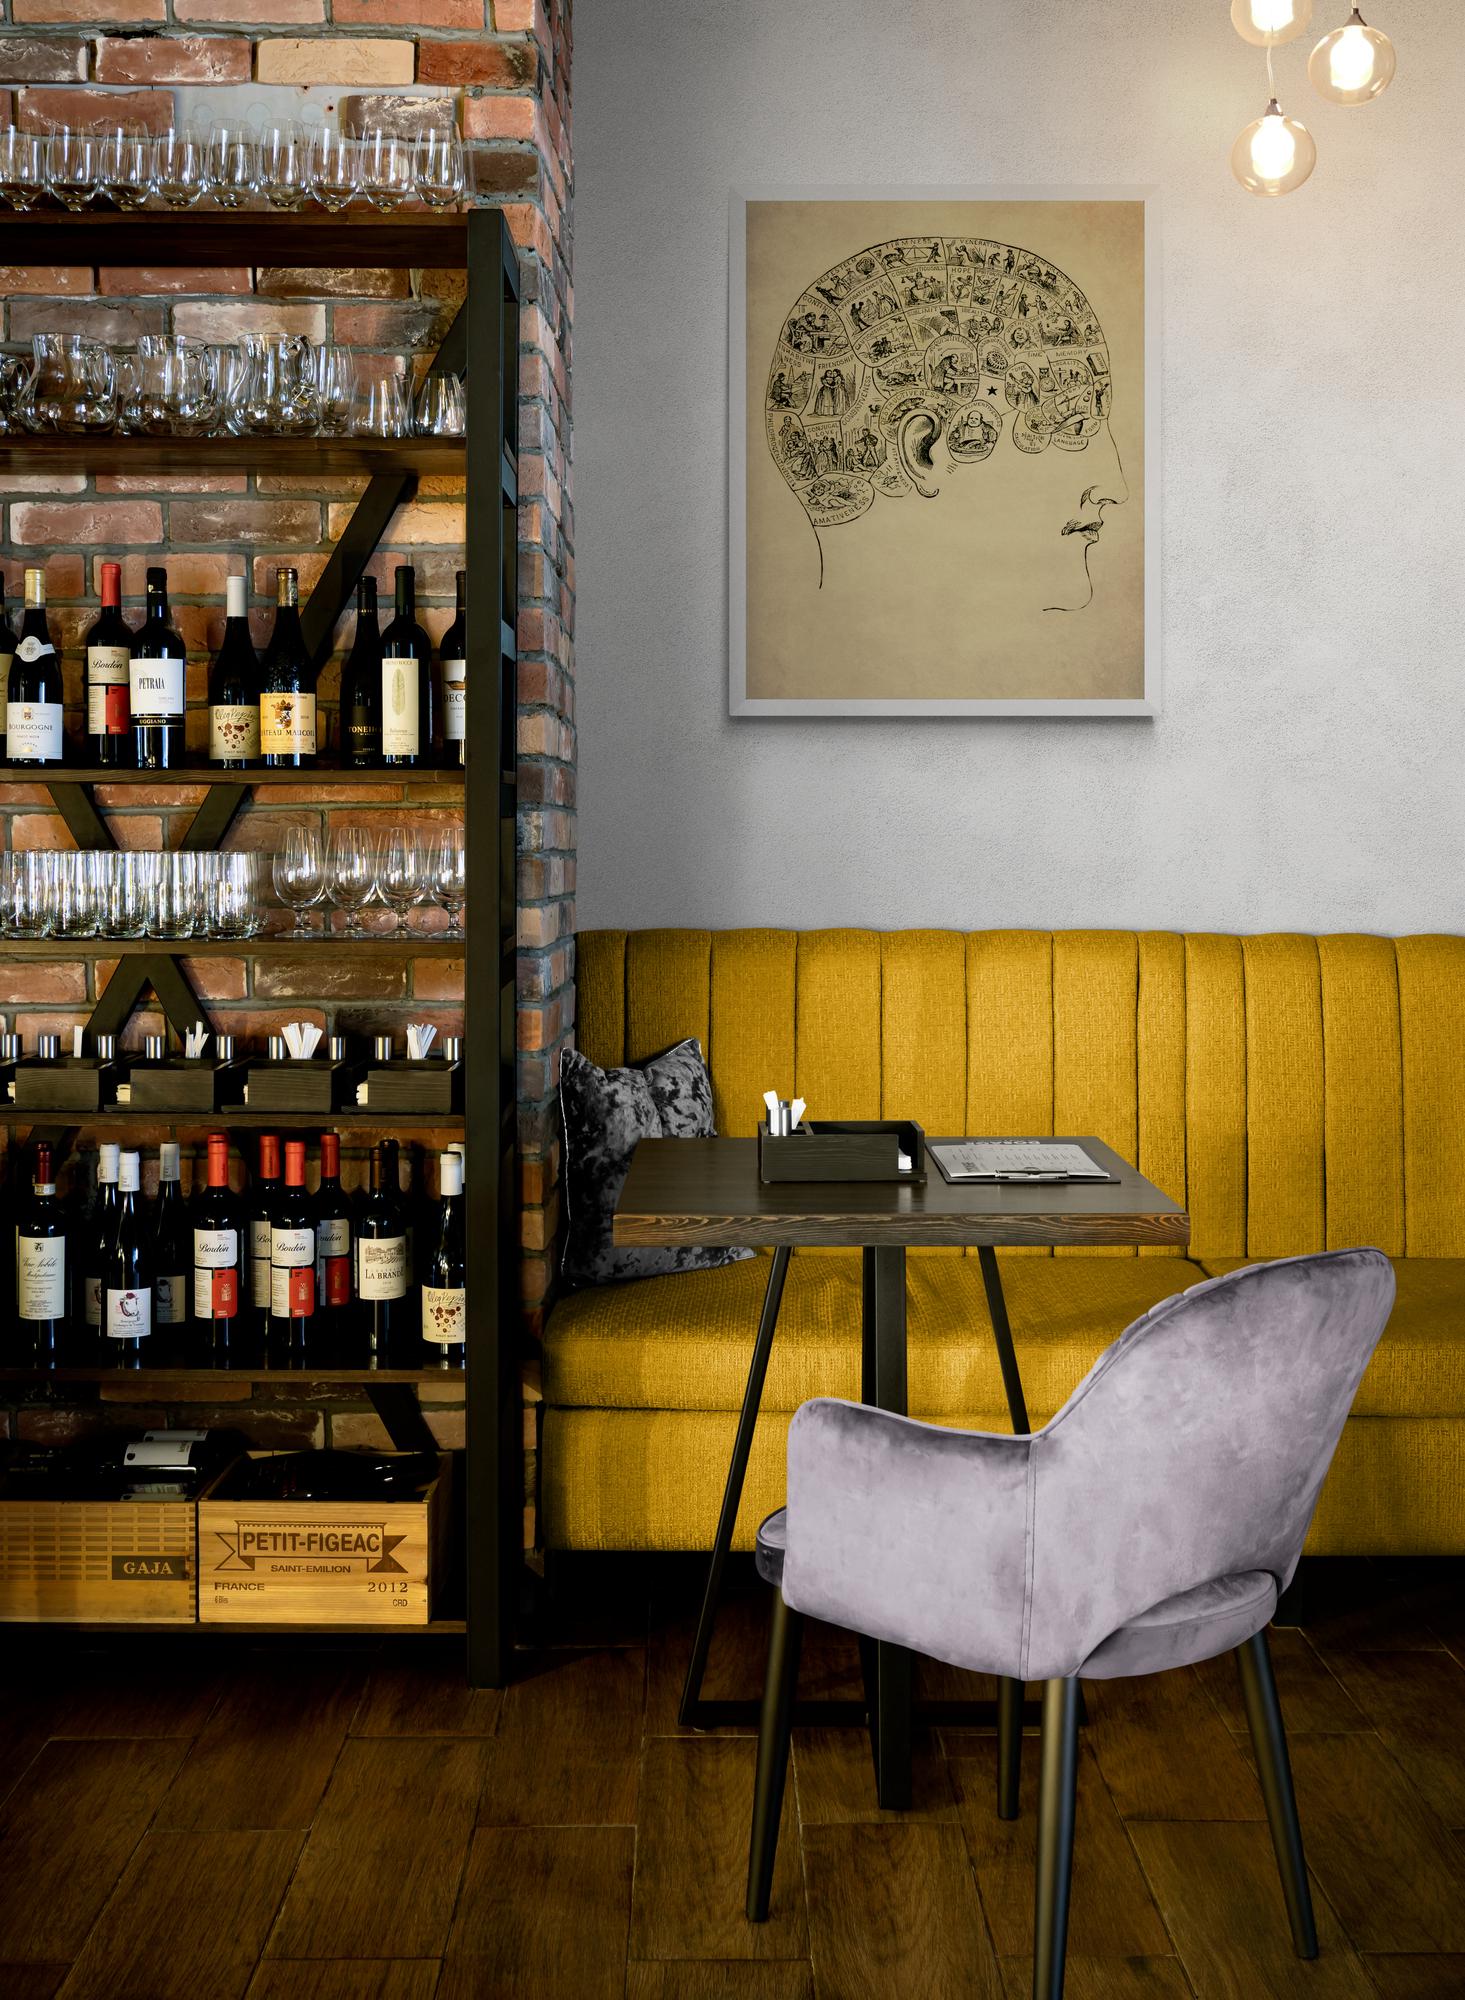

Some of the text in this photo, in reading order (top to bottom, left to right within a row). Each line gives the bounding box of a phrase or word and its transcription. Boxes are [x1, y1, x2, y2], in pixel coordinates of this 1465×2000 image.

[886, 238, 932, 250] FIRMNESS
[960, 239, 1001, 250] VENERATION
[1056, 349, 1088, 357] MEMORY
[818, 354, 854, 369] FRIENDSHIP
[842, 375, 871, 426] COMBATIVENESS
[881, 390, 940, 425] DESTRUCTIVENESS
[807, 423, 839, 432] CONJUGAL
[1053, 437, 1085, 445] LANGUAGE
[813, 496, 870, 525] AMATIVENESS
[138, 677, 165, 690] PETRAIA
[8, 723, 53, 731] BOURGOGNE
[199, 1242, 229, 1253] Bordón
[275, 1242, 307, 1252] Bordón
[365, 1269, 375, 1279] LA
[243, 1532, 380, 1553] PETIT-FIGEAC
[123, 1561, 174, 1575] GAJA
[270, 1565, 351, 1574] SAINT-EMILION
[214, 1582, 265, 1591] FRANCE
[367, 1582, 409, 1593] 2012
[392, 1598, 408, 1607] CRD
